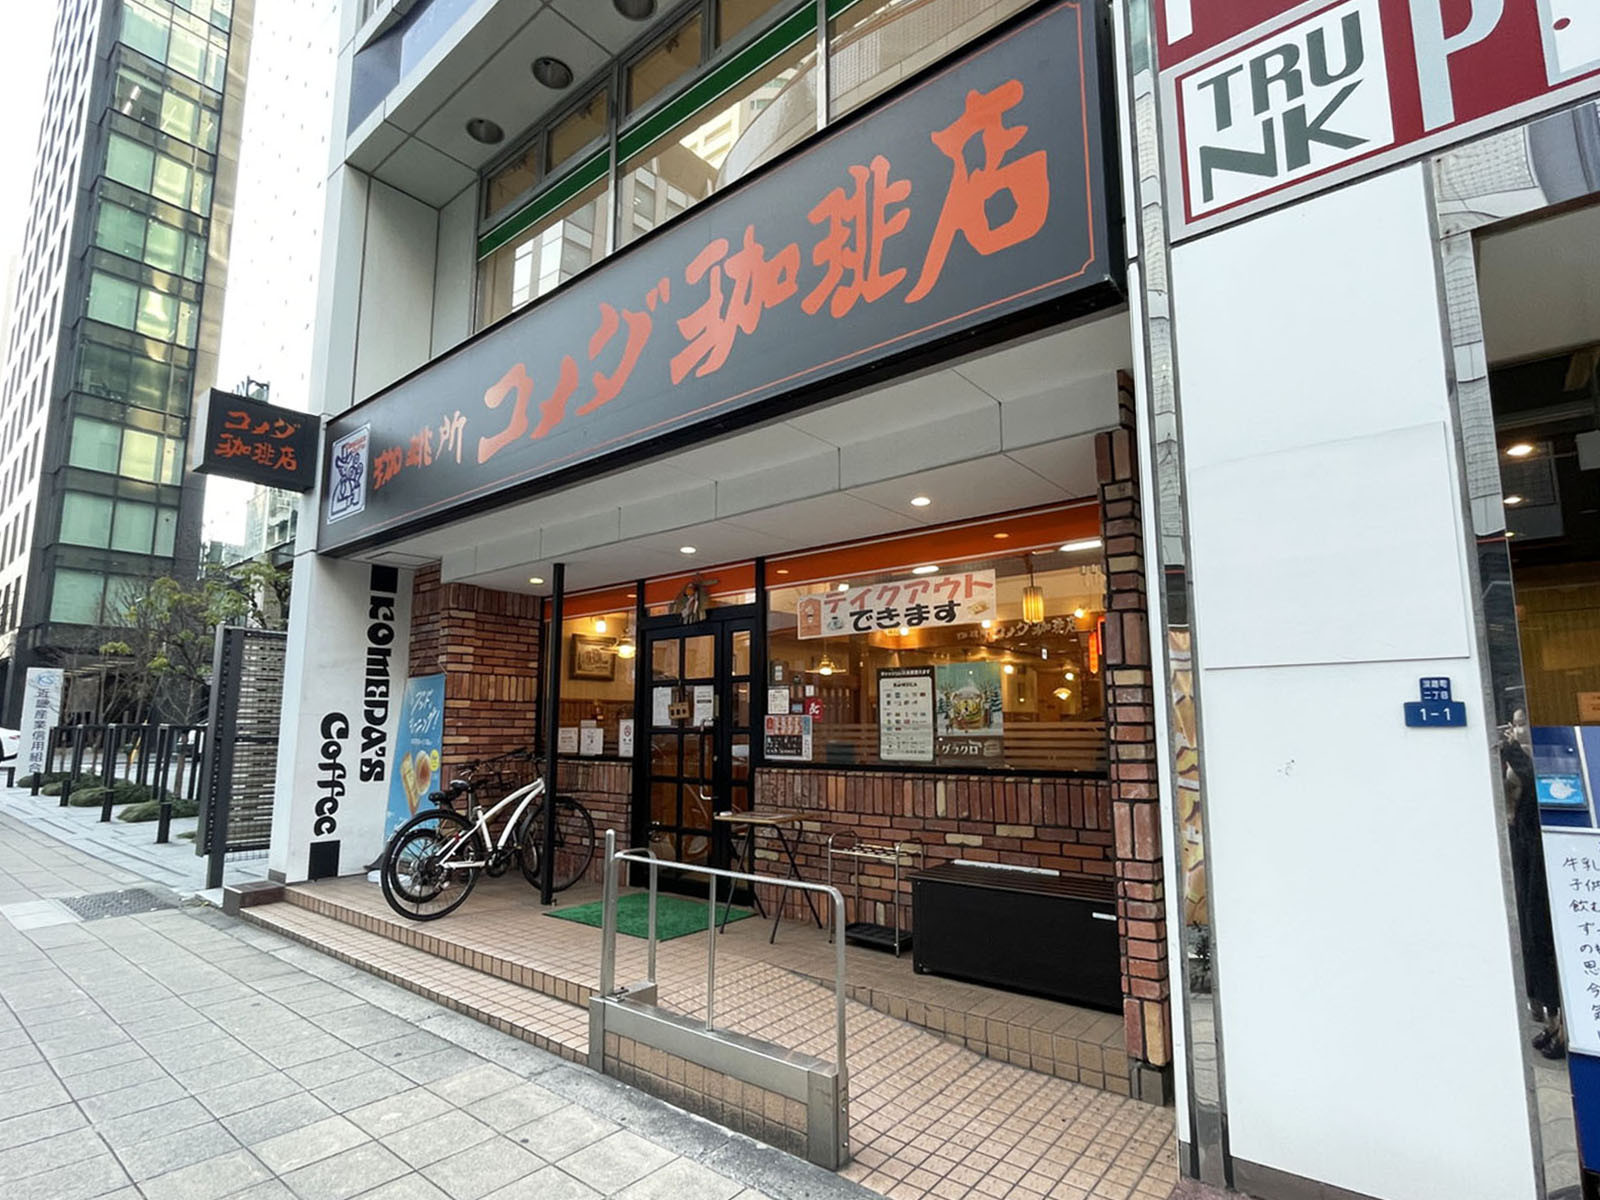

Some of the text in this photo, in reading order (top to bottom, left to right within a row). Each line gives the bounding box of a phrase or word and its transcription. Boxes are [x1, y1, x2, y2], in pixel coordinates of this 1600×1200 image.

[373, 79, 1050, 490] 珈琲所 コメダ珈琲店
[224, 410, 301, 439] コメダ
[213, 433, 298, 471] 珈琲店
[823, 574, 993, 614] テイクアウト
[850, 600, 961, 632] できます
[1419, 707, 1451, 721] 1-1
[1578, 921, 1600, 936] ず
